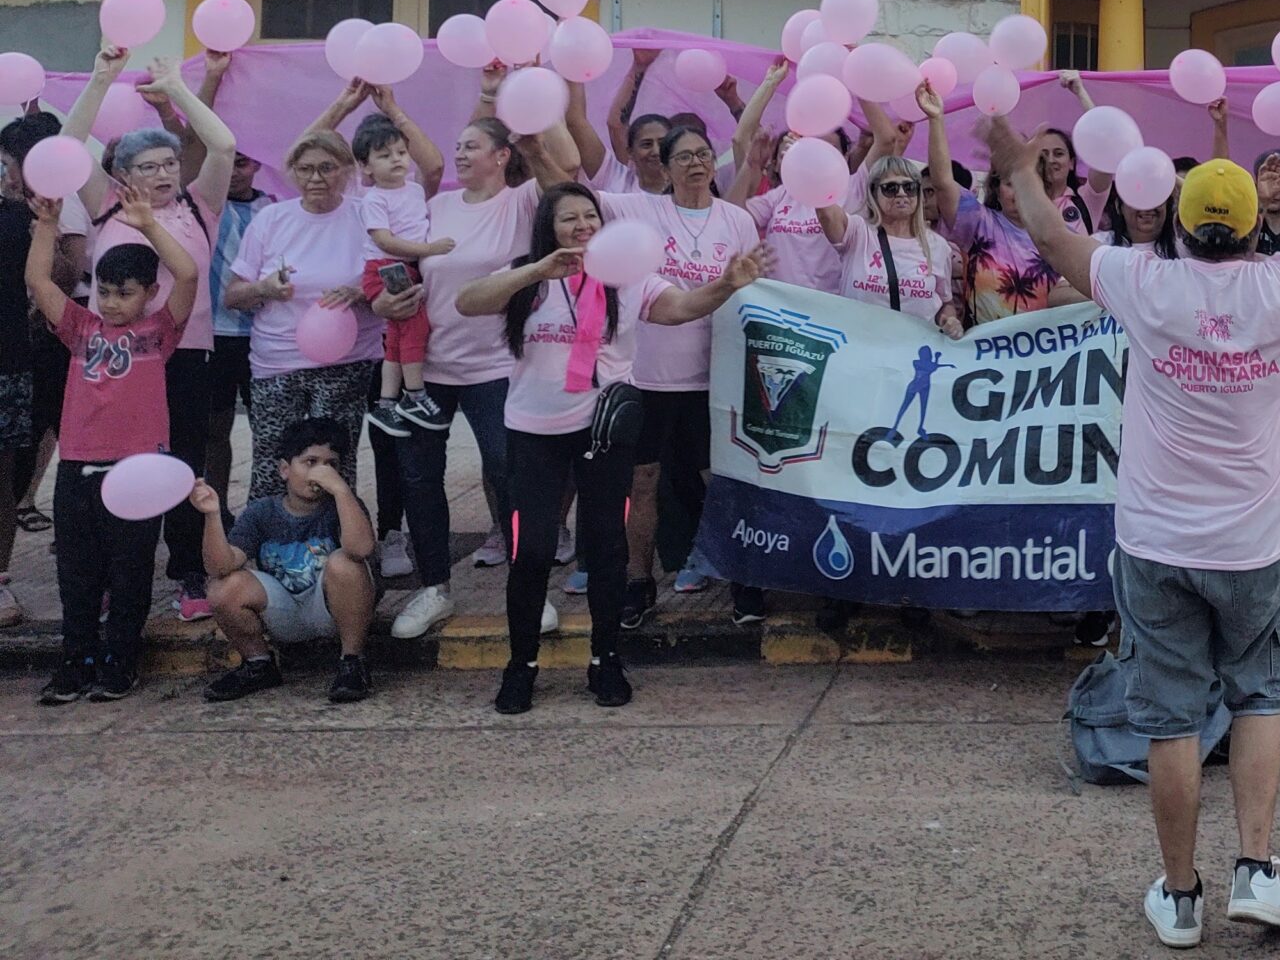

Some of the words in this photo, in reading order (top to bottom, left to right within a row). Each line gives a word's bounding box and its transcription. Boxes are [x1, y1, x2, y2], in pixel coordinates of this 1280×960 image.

[656, 267, 703, 282] AMINATA
[853, 280, 905, 297] CAMINA
[898, 279, 926, 289] UAZÚ
[747, 338, 783, 351] PUERTO
[1169, 344, 1262, 368] GIMNASIA
[1152, 357, 1280, 383] COMUNITARIA
[1180, 383, 1217, 394] PUERTO
[731, 518, 790, 552] Apoya
[870, 528, 1096, 581] Manantial
